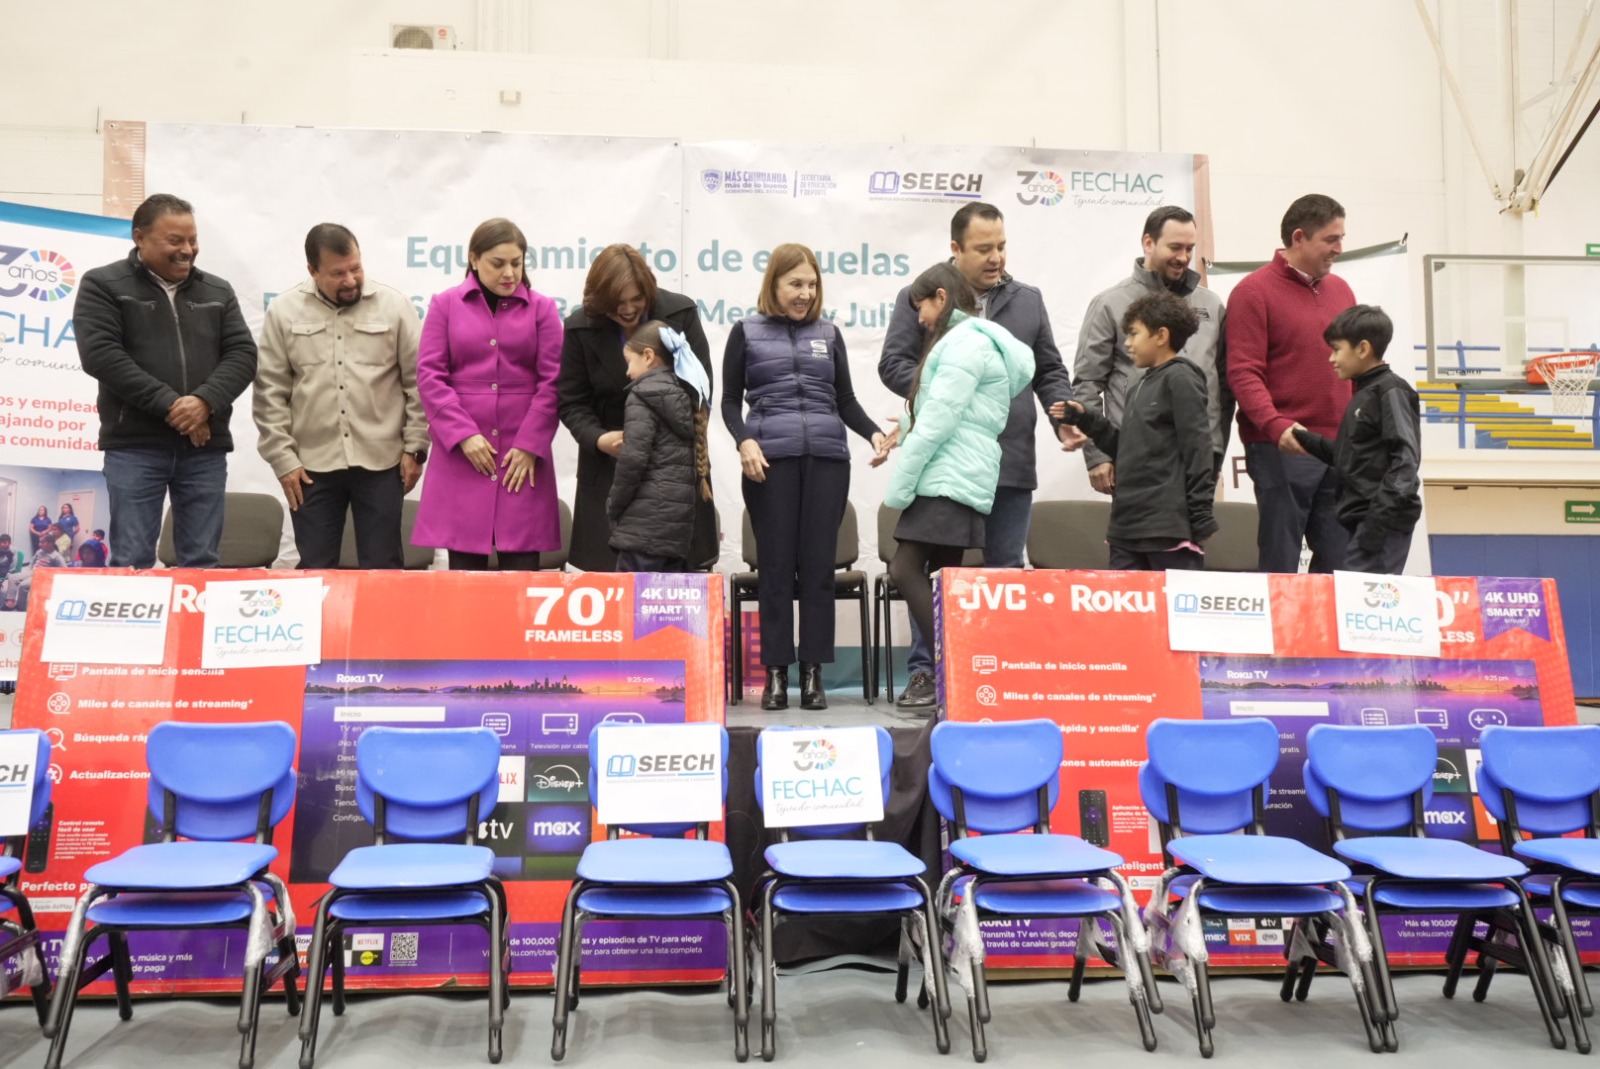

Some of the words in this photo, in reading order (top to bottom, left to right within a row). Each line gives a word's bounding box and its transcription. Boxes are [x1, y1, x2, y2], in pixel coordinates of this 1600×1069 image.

[724, 169, 741, 182] MÁS
[743, 171, 787, 183] CHIHUAHUA
[1071, 171, 1163, 193] FECHAC
[902, 173, 983, 192] SEECH
[406, 236, 677, 274] Equamito
[697, 239, 743, 272] de
[752, 243, 910, 276] euelas
[8, 263, 58, 283] años
[18, 397, 28, 410] y
[57, 419, 86, 432] por
[641, 587, 664, 600] 4K
[667, 588, 702, 600] UHD
[960, 583, 1027, 611] JVC
[1484, 591, 1505, 603] 4K
[1507, 592, 1539, 604] UHD
[641, 604, 683, 615] SMART
[685, 605, 702, 614] TV
[1200, 595, 1265, 612] SEECH
[88, 601, 164, 619] SEECH
[1486, 608, 1524, 617] SMART
[1525, 608, 1541, 617] TV
[1345, 612, 1423, 634] FECHAC
[214, 623, 304, 644] FECHAC
[525, 629, 624, 643] FRAMELESS
[82, 667, 128, 675] Pantalla
[148, 667, 178, 676] inicio
[1001, 661, 1042, 670] Pantalla
[1044, 662, 1057, 670] de
[1059, 661, 1087, 670] inicio
[1089, 661, 1128, 671] sencilla
[367, 673, 384, 684] TV
[1254, 670, 1268, 679] TV
[1003, 691, 1029, 700] Miles
[1031, 692, 1044, 700] de
[1047, 692, 1085, 701] canales
[1088, 692, 1100, 701] de
[78, 700, 108, 708] Miles
[111, 700, 125, 708] de
[128, 699, 172, 708] canales
[175, 700, 189, 708] de
[340, 709, 362, 718] Inicio
[1059, 724, 1087, 735] ápida
[1089, 727, 1096, 735] y
[73, 733, 129, 744] Búsqueda
[1280, 746, 1300, 754] gratis
[638, 753, 716, 773] SEECH
[533, 764, 584, 793] Disney+
[772, 776, 863, 800] FECHAC
[1423, 811, 1467, 824] max
[533, 821, 582, 836] max
[21, 881, 76, 892] Perfecto
[1404, 919, 1419, 927] Más
[1571, 919, 1591, 927] elegir
[522, 937, 556, 946] 100,000
[599, 936, 636, 945] episodios
[637, 936, 648, 944] de
[649, 935, 661, 944] TV
[681, 935, 703, 943] elegir
[980, 930, 1016, 938] Transmite
[1018, 930, 1028, 938] TV
[1040, 931, 1057, 939] vivo,
[611, 947, 639, 955] obtener
[670, 946, 703, 955] completa
[986, 940, 1009, 948] través
[1010, 940, 1020, 948] de
[1021, 940, 1049, 949] canales
[138, 952, 167, 962] música
[175, 952, 193, 961] más
[131, 965, 143, 973] de
[144, 965, 166, 973] paga
